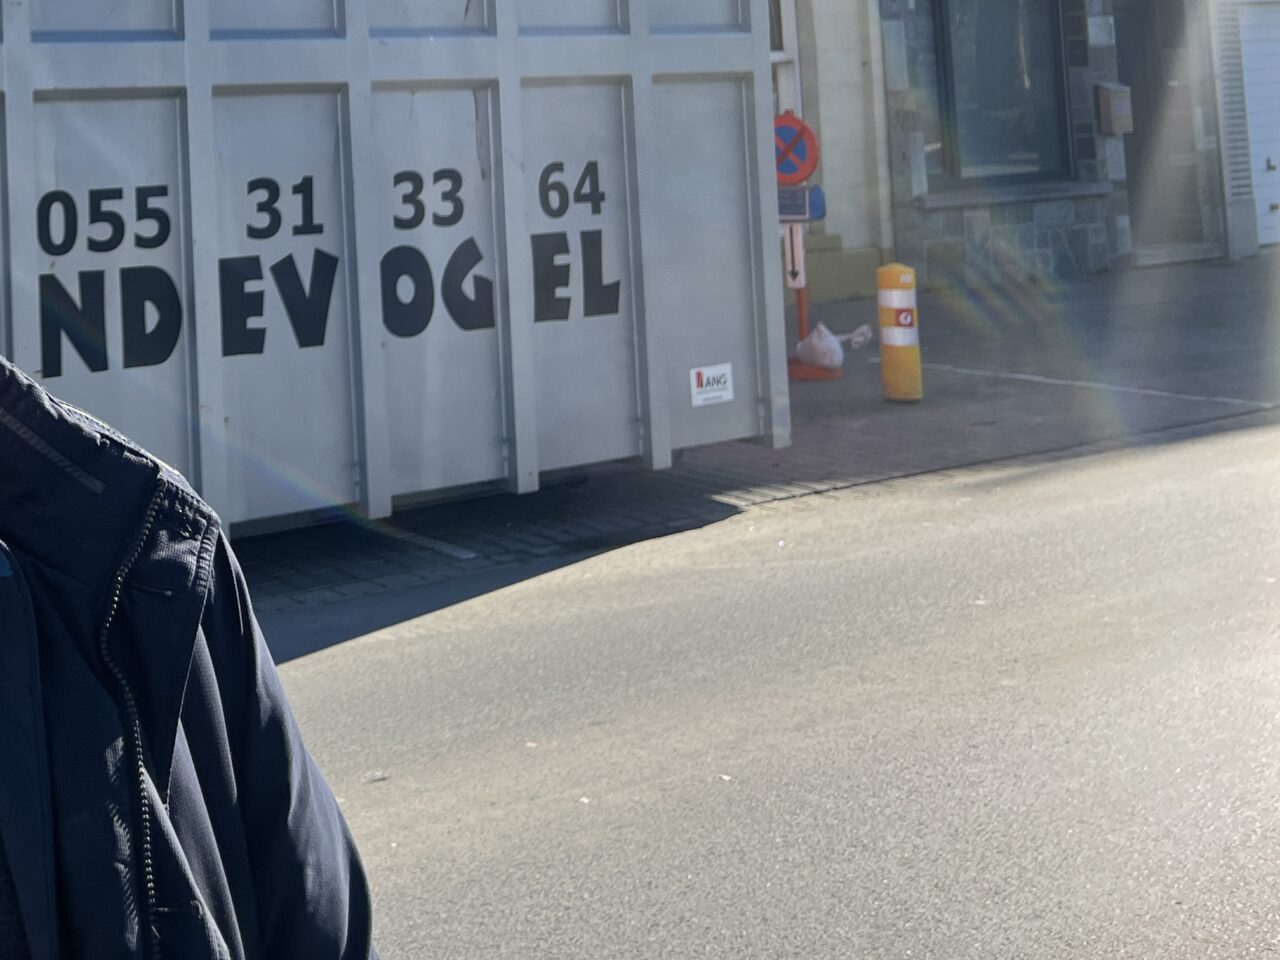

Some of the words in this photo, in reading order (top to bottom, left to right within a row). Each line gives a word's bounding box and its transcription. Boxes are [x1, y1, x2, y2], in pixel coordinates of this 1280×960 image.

[37, 184, 171, 256] 055
[246, 175, 324, 239] 31
[393, 168, 464, 230] 33
[538, 160, 606, 218] 64
